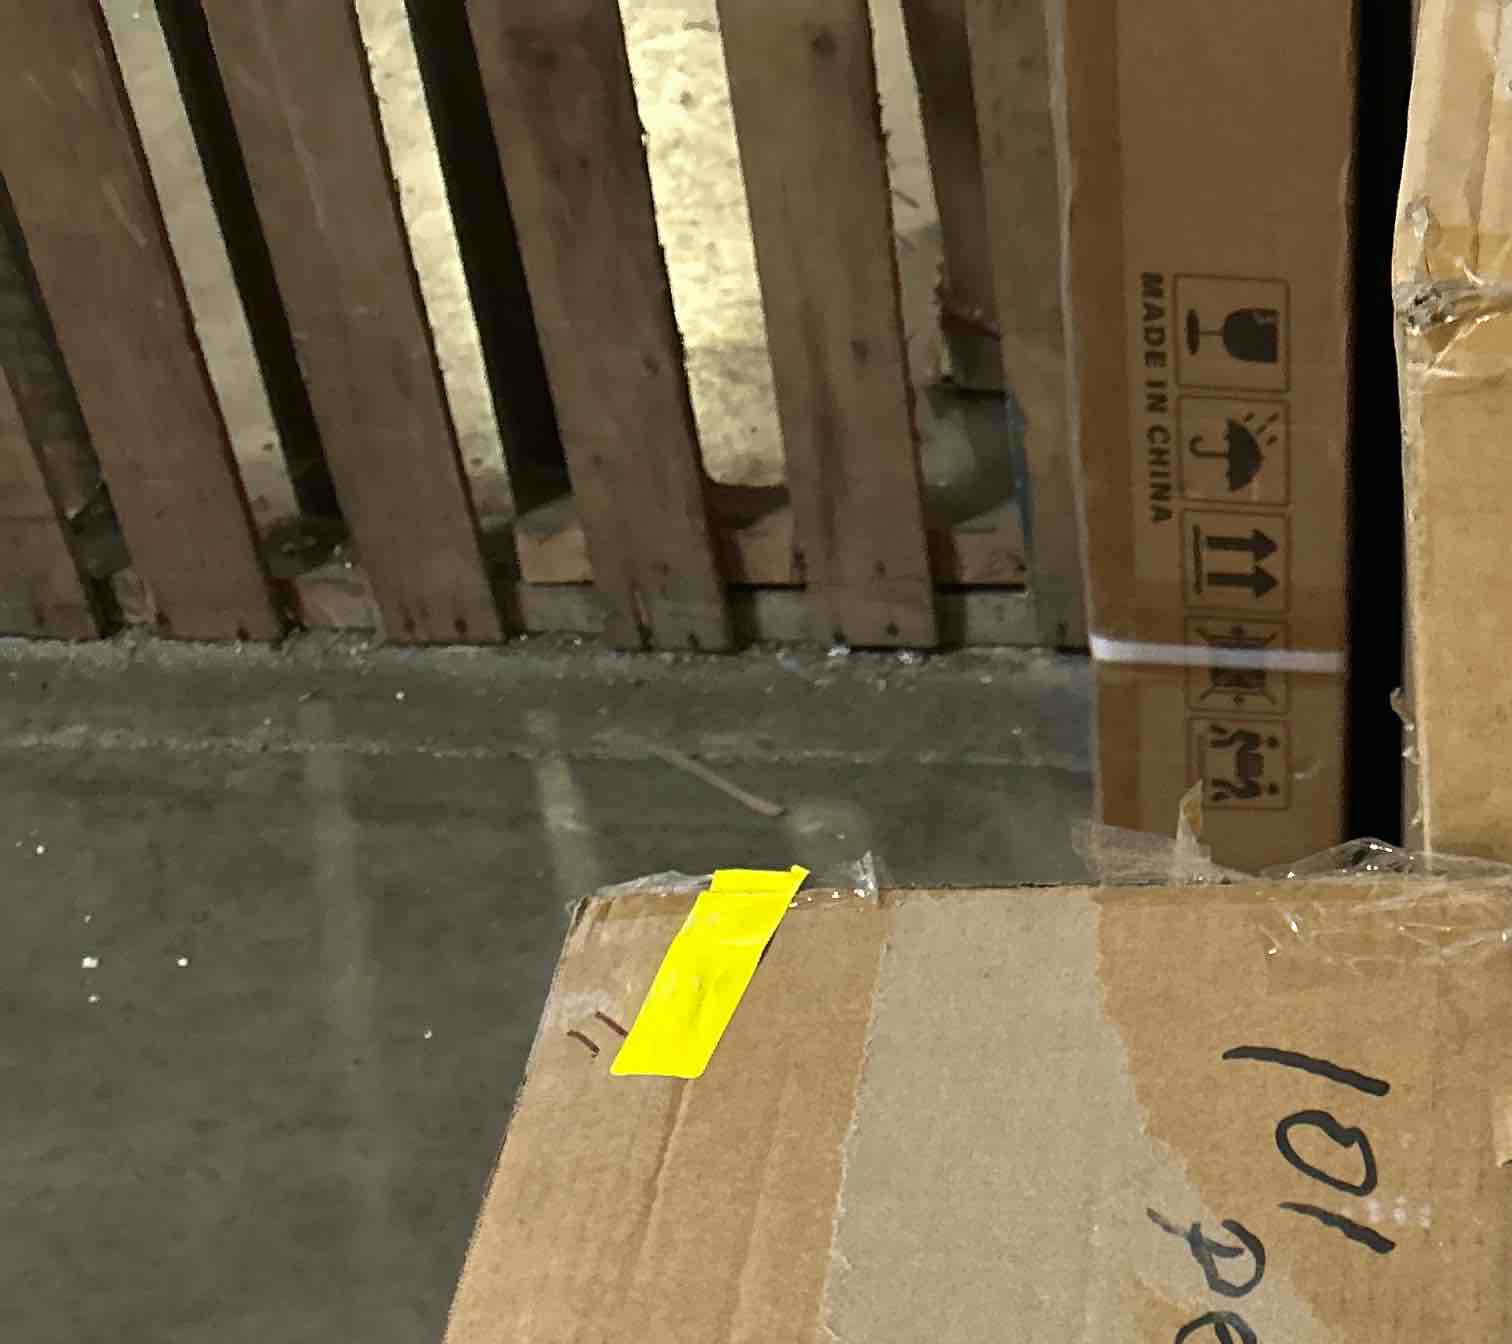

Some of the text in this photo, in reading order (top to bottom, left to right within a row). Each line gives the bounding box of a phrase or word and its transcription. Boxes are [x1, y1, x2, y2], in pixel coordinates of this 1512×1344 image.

[1141, 271, 1174, 523] MADE IN CHINA
